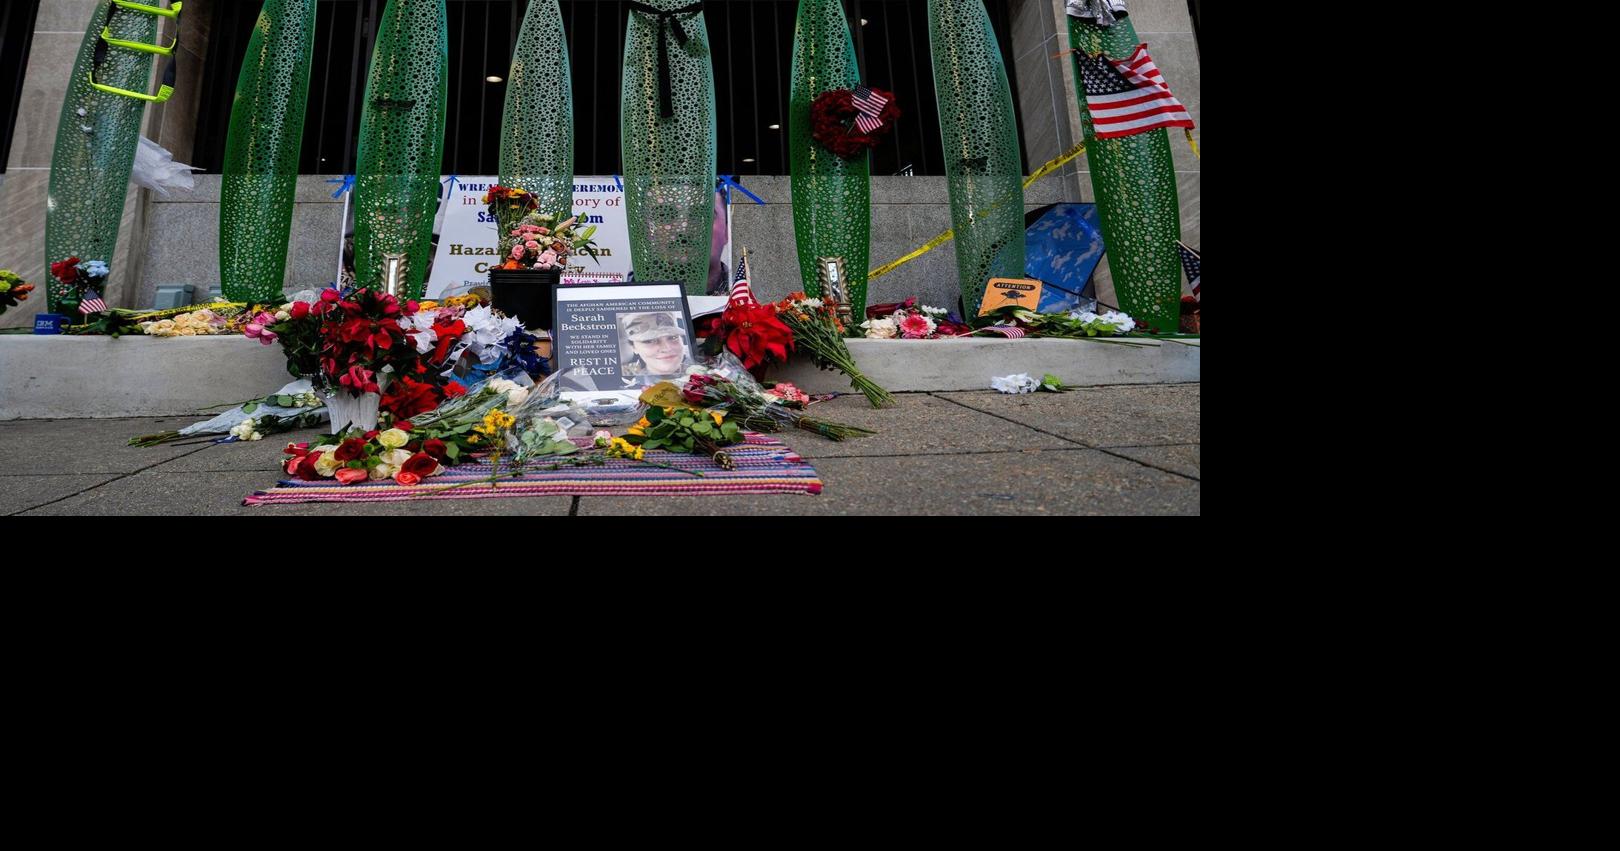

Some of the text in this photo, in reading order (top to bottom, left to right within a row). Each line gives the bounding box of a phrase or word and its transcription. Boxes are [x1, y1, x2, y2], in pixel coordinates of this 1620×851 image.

[459, 183, 624, 193] WREA EREMON
[463, 195, 622, 209] in ory of
[477, 211, 498, 223] Sa
[573, 247, 612, 257] ican
[571, 313, 605, 322] Sarah
[561, 322, 617, 331] Beckstrom
[570, 357, 617, 366] REST IN
[573, 366, 615, 376] PEACE
